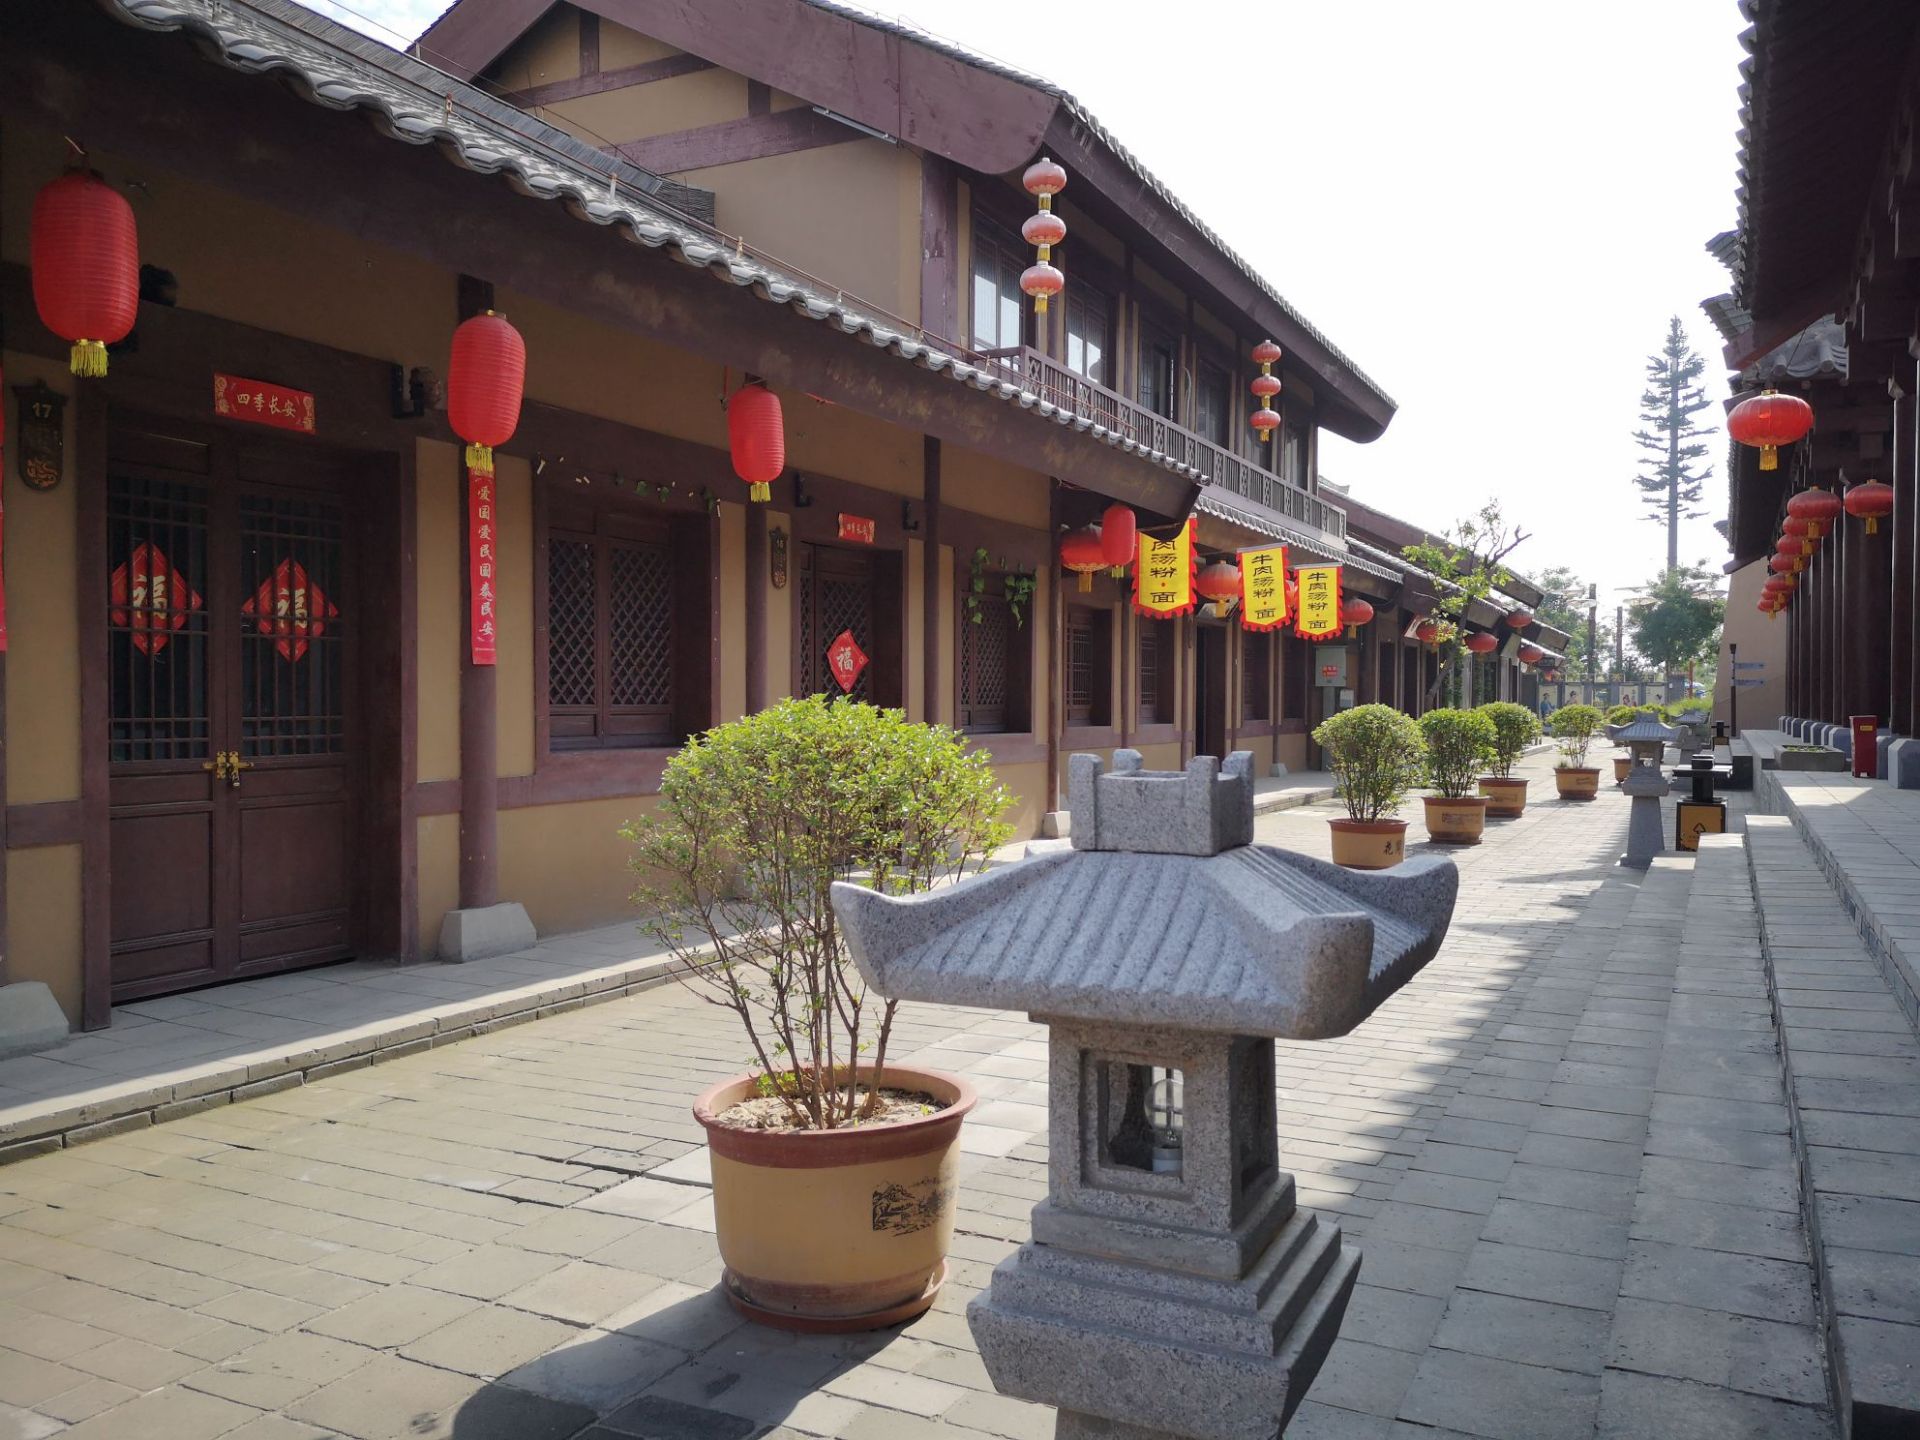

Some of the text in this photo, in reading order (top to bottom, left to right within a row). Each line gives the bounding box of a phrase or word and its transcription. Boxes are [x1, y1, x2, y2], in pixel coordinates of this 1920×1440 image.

[32, 402, 52, 418] 17
[237, 393, 296, 418] 四季长安
[133, 575, 168, 618] 福
[277, 588, 308, 629] 福
[836, 646, 854, 672] 福
